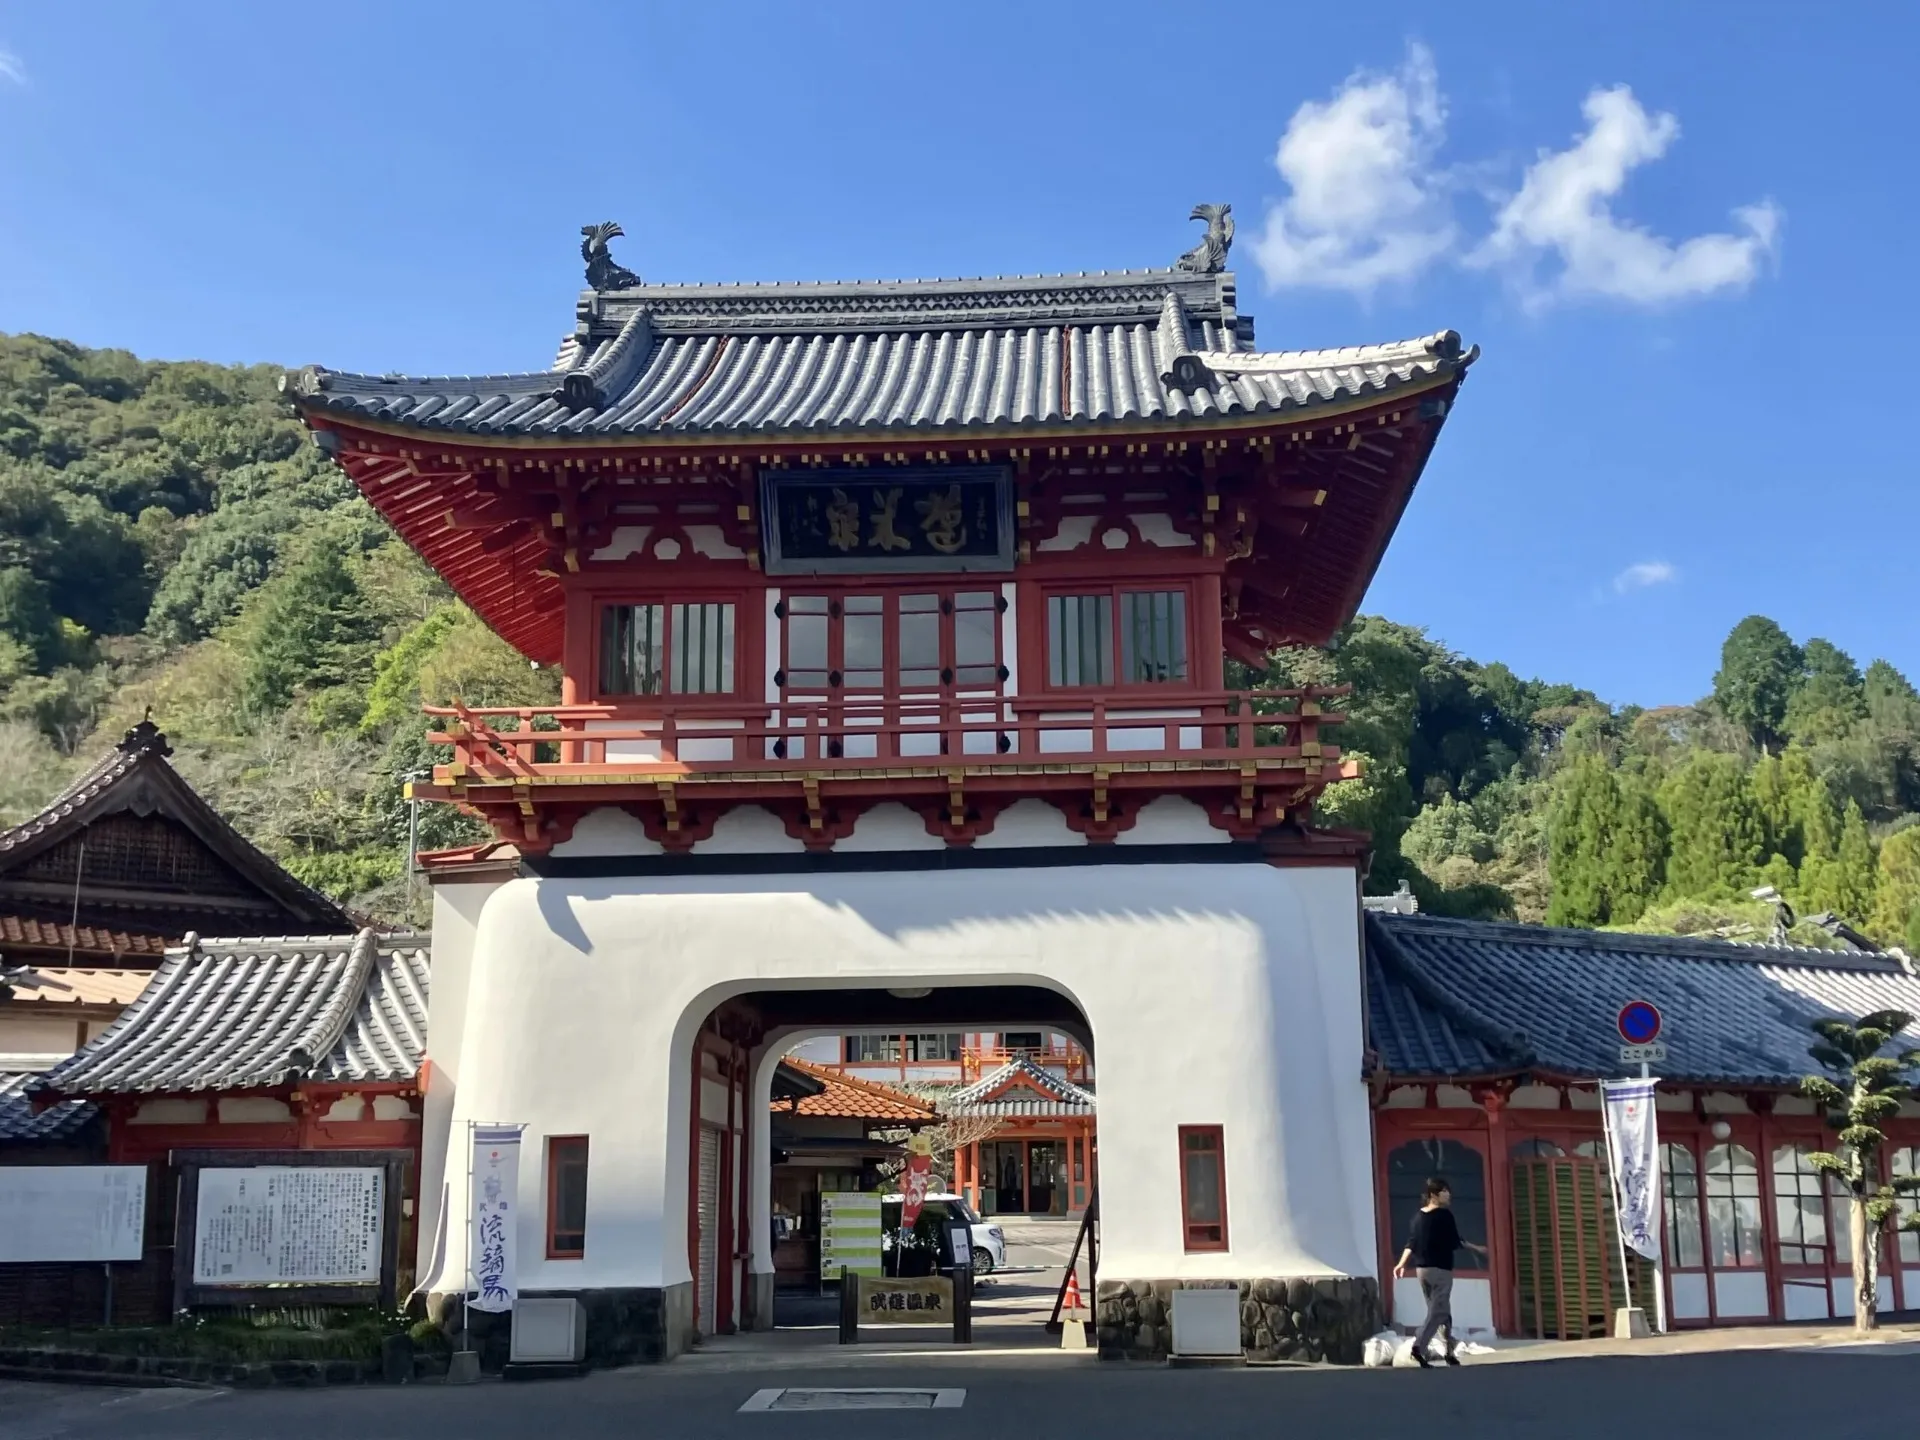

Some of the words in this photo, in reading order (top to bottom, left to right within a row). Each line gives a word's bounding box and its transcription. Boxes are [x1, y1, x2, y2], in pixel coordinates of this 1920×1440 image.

[1623, 1047, 1664, 1060] ここから
[479, 1214, 508, 1302] 流鏑馬
[870, 1292, 942, 1311] 武雄温泉
